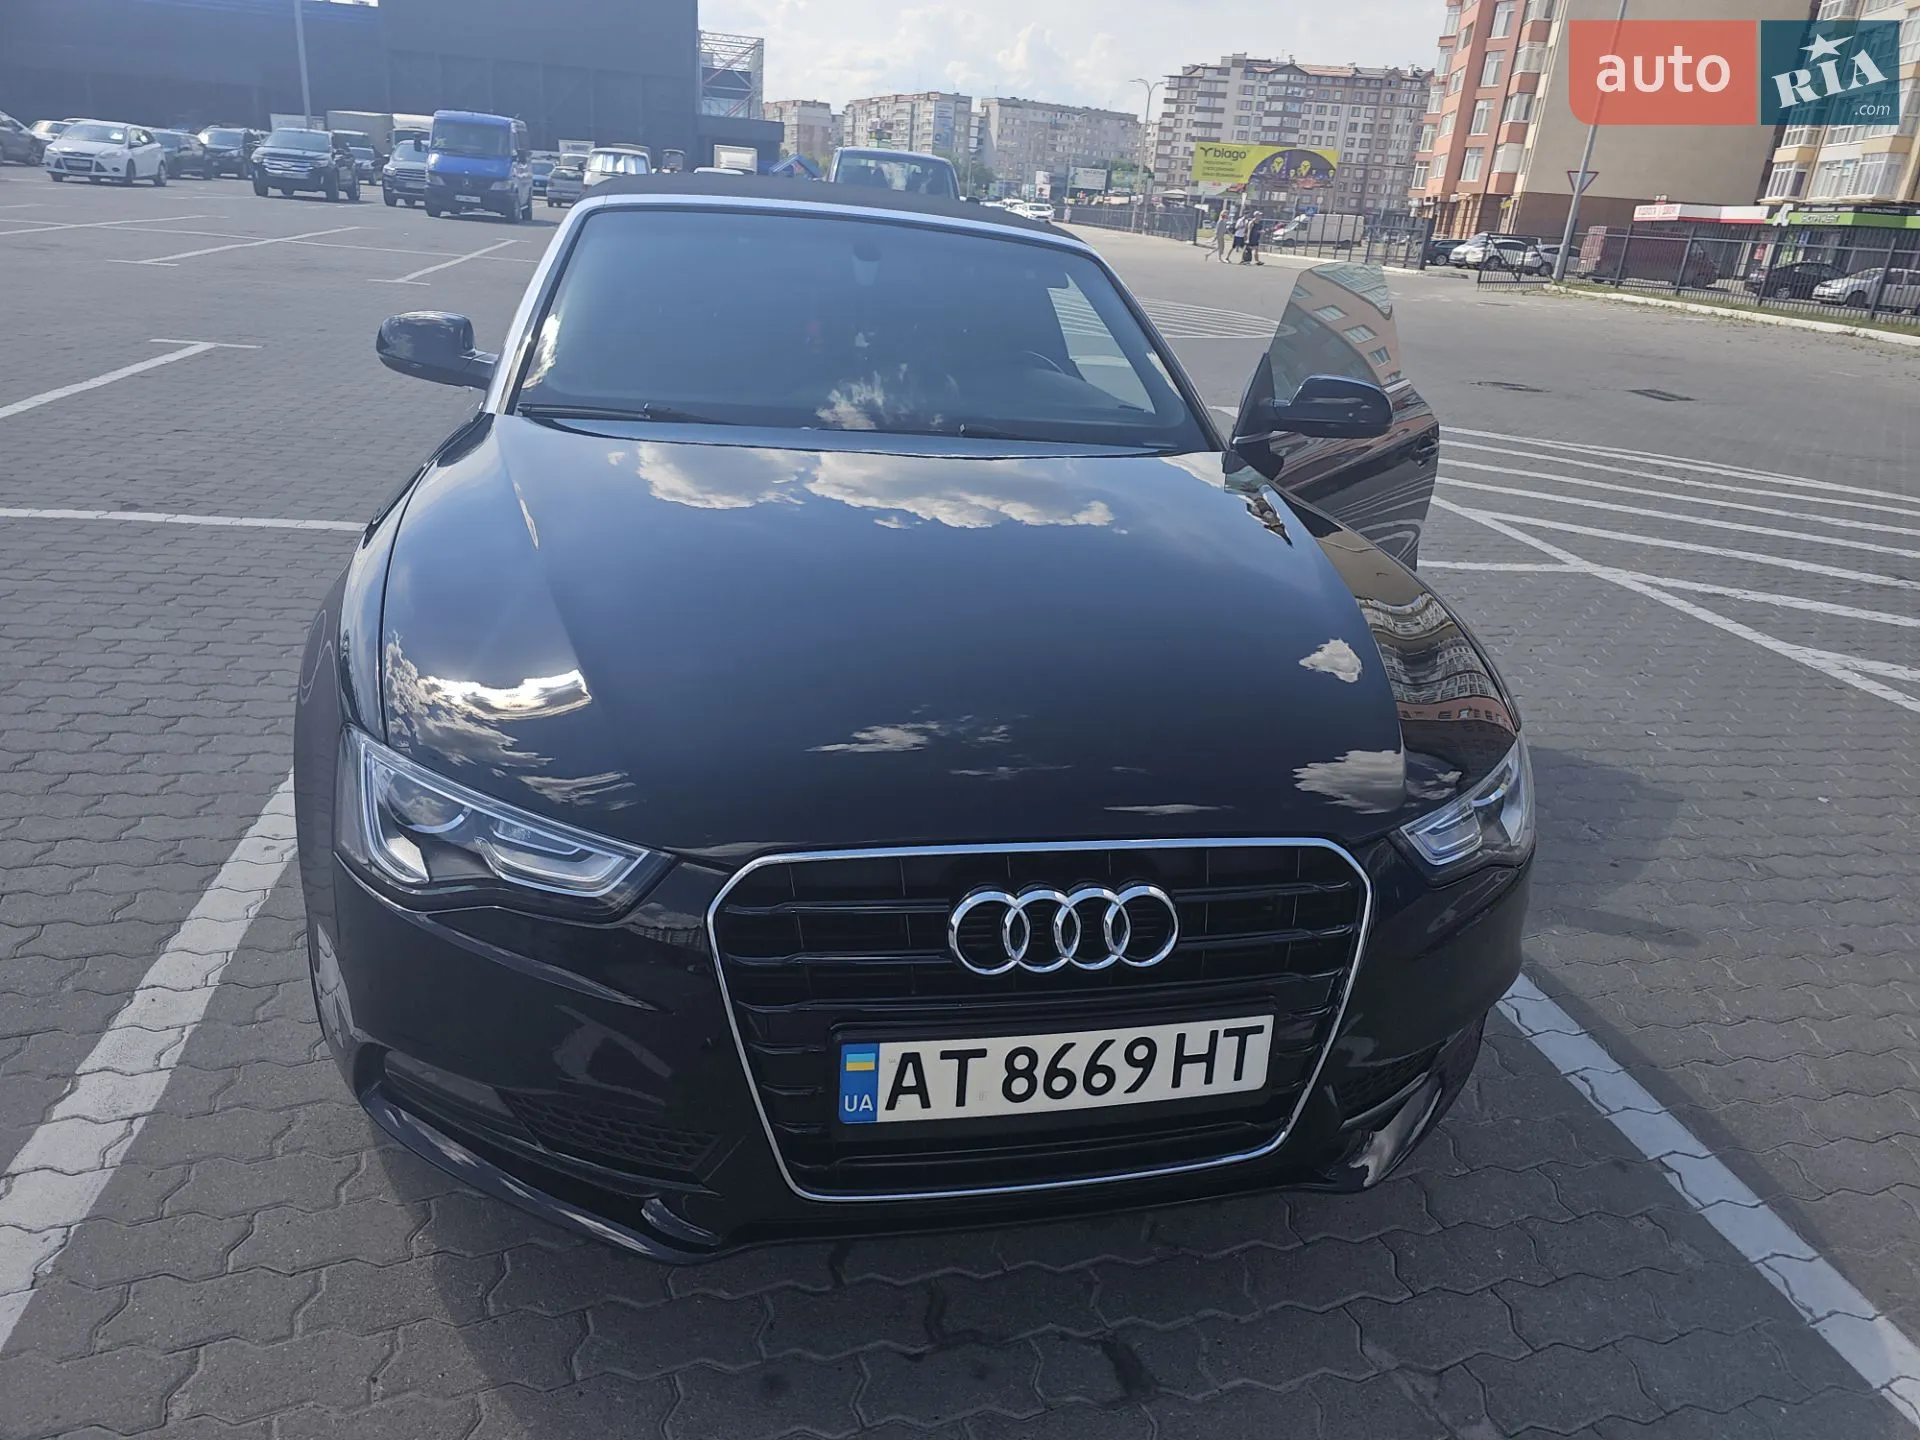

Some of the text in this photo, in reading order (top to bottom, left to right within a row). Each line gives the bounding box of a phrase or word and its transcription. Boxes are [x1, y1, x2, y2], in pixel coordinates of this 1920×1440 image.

[884, 1024, 1265, 1111] AT 8669 HT
[844, 1094, 874, 1113] UA
